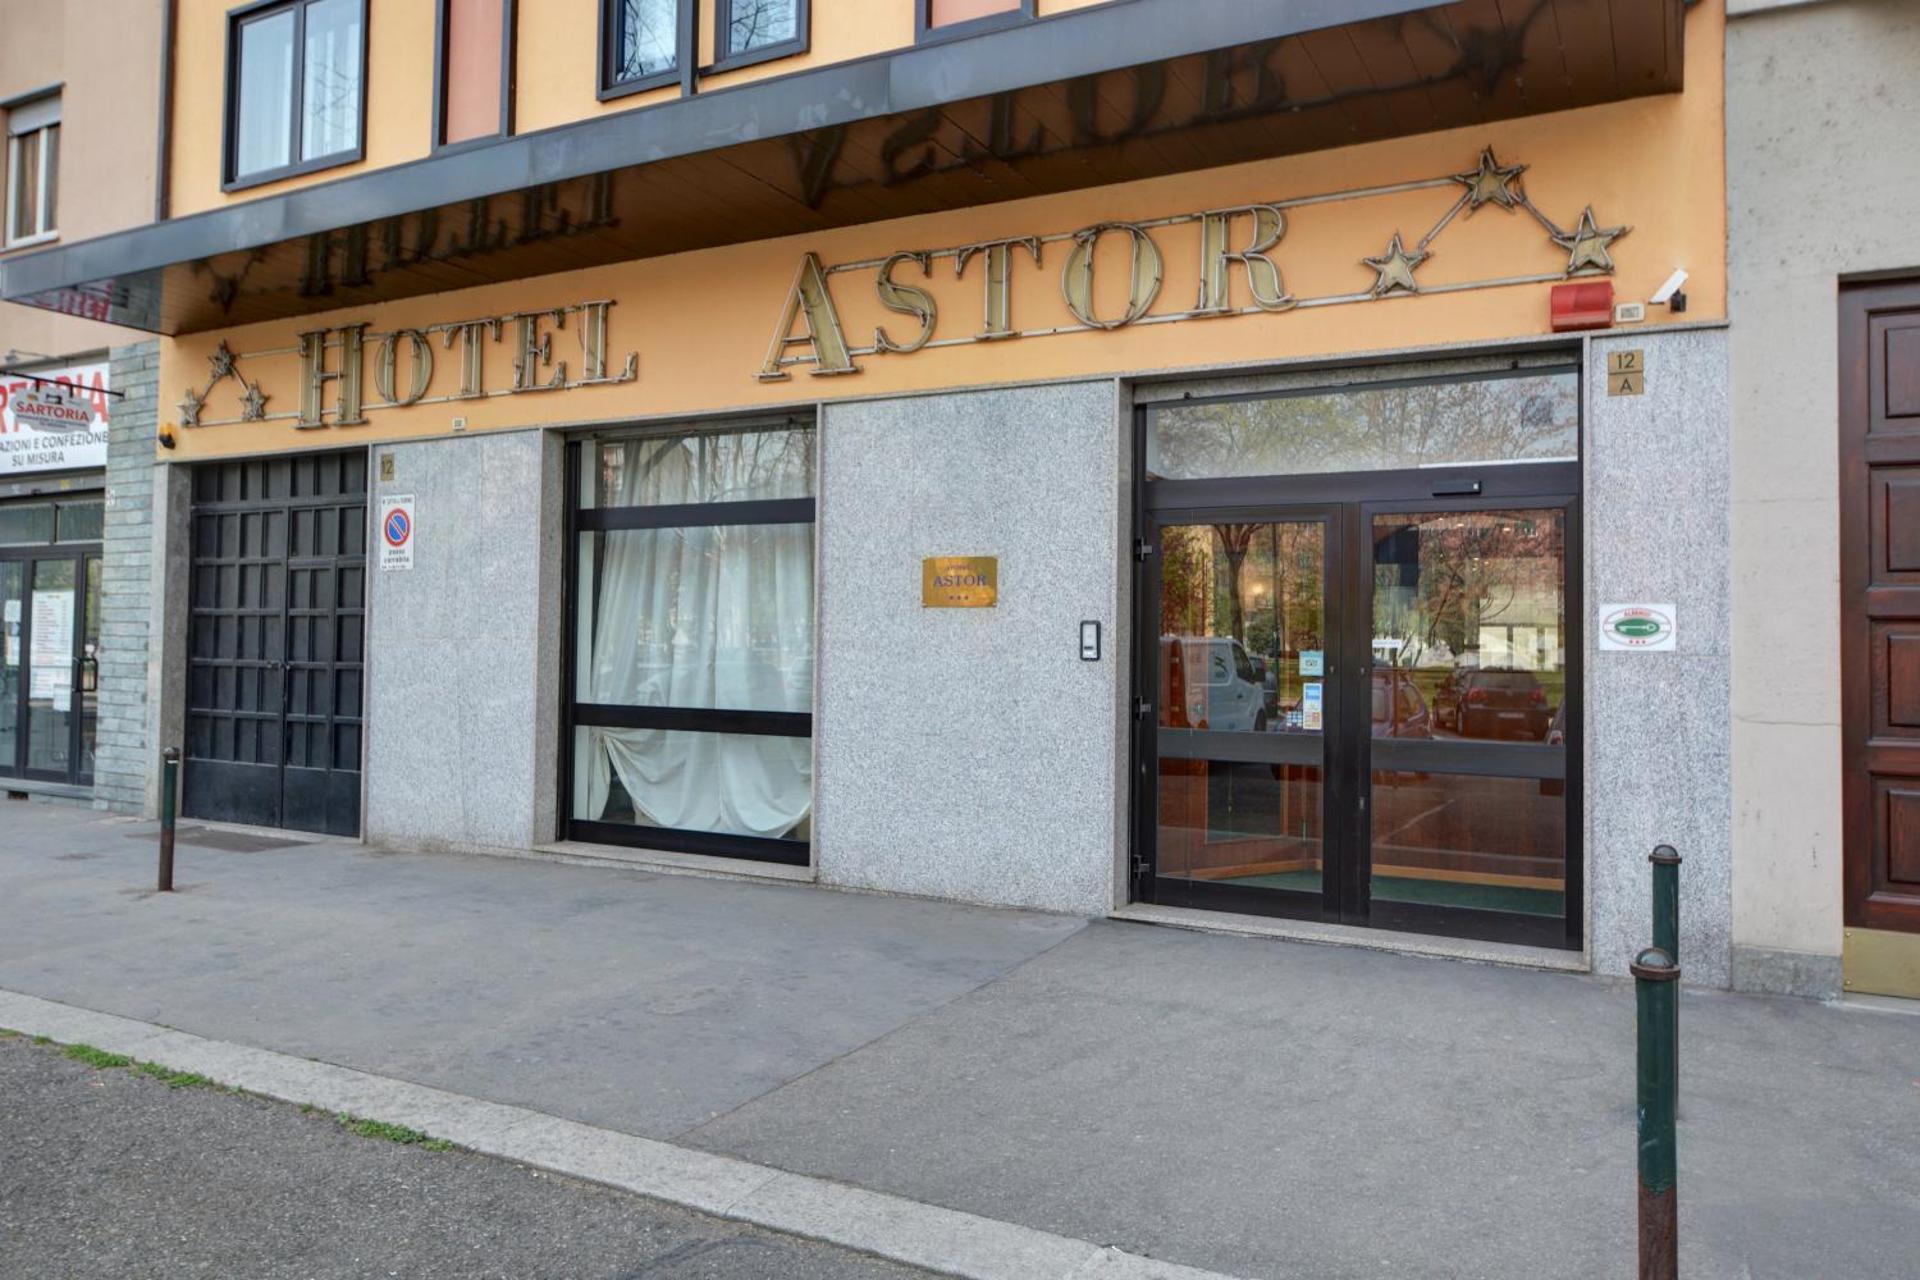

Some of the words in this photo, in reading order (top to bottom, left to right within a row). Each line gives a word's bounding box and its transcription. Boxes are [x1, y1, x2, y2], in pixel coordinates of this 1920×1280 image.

[294, 300, 638, 430] HOTEL
[753, 206, 1296, 381] ASTOR
[1617, 353, 1635, 369] 12
[1619, 378, 1633, 392] A
[16, 400, 90, 422] SARTORIA
[41, 431, 108, 449] CONFEZIONE
[12, 454, 24, 466] SU
[27, 451, 65, 465] MISURA
[382, 459, 393, 475] 12
[933, 575, 987, 588] ASTOR
